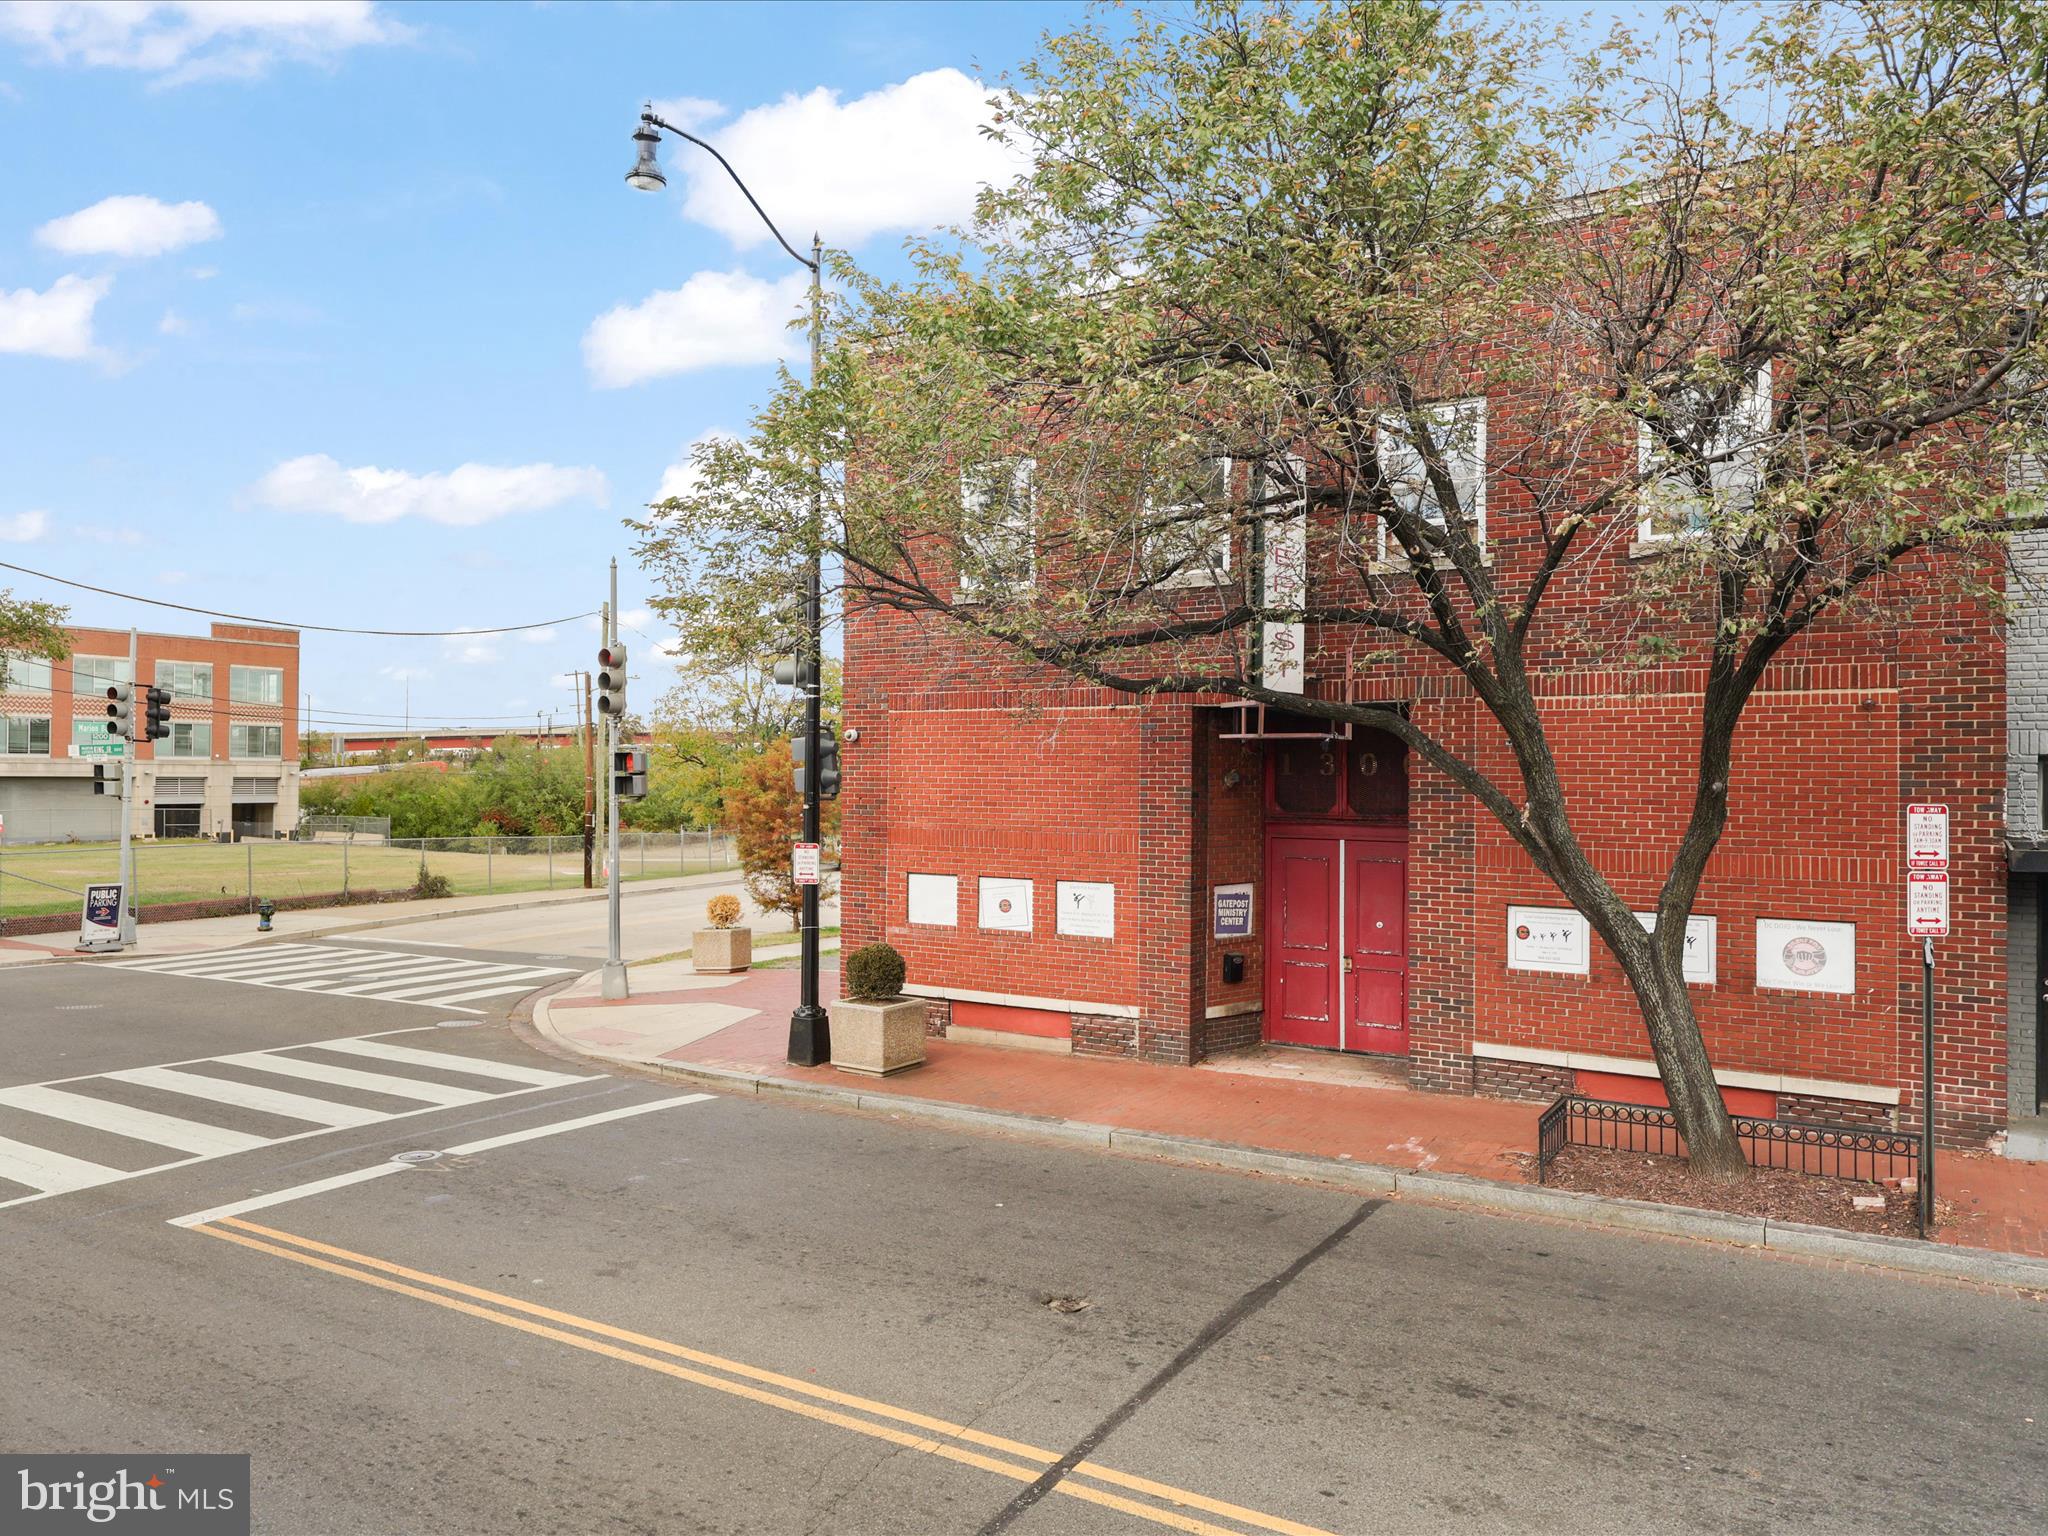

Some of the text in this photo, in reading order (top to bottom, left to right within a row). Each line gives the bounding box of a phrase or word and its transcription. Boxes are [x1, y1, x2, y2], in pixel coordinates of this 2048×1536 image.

[91, 889, 118, 899] PUBLIC
[90, 899, 117, 907] PARKING
[1217, 899, 1249, 908] GATEPOST
[1217, 909, 1248, 917] MINISTRY
[1220, 917, 1244, 926] CENTER
